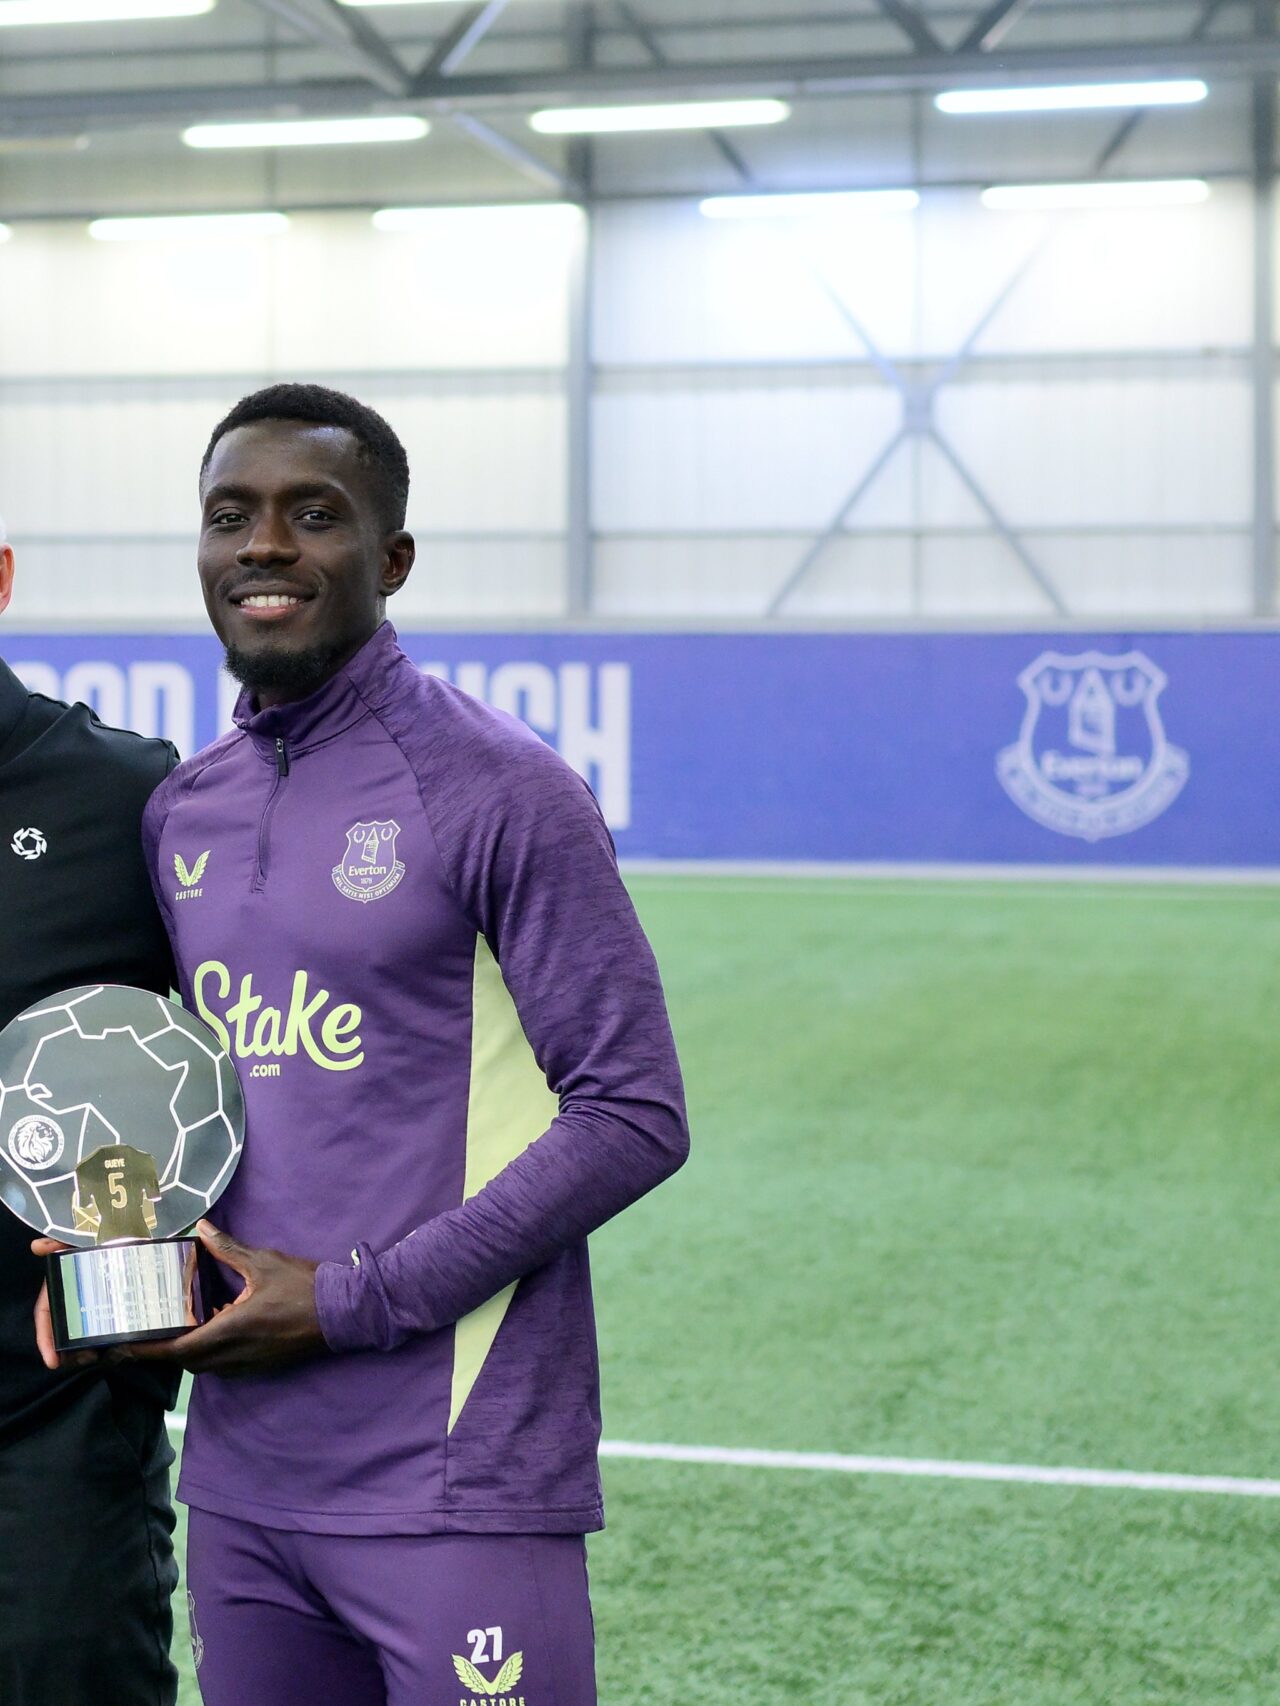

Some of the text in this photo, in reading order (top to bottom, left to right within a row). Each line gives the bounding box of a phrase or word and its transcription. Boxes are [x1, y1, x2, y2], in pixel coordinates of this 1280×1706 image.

[348, 865, 387, 877] Everton
[175, 888, 203, 901] CASTORE
[194, 960, 365, 1071] Stake
[249, 1063, 281, 1077] .com
[104, 1158, 125, 1169] GUEYE
[107, 1171, 128, 1209] 5
[466, 1625, 503, 1665] 27
